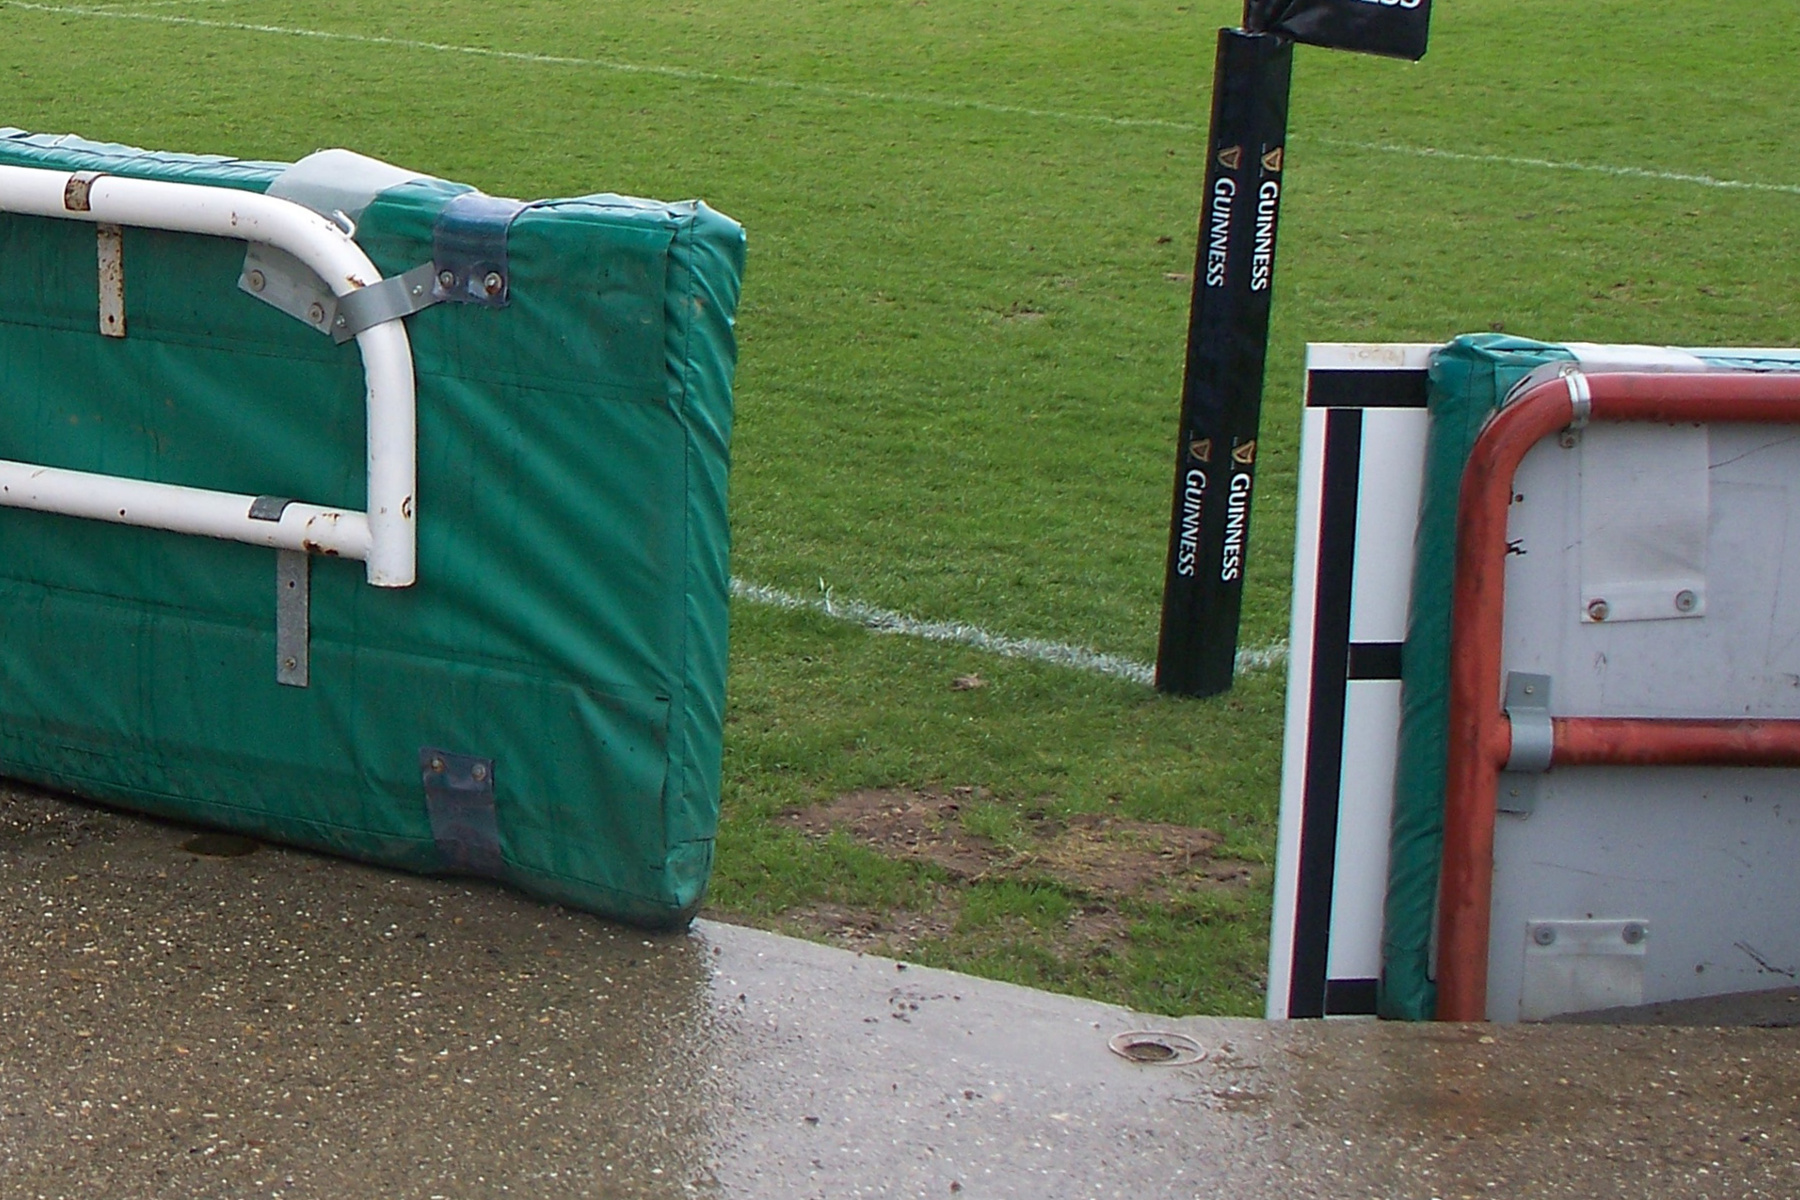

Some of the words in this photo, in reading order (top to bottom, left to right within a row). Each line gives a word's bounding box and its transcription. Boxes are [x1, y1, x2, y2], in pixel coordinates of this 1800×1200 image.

[1206, 177, 1236, 288] GUINNESS
[1251, 181, 1279, 292] GUINNESS
[1177, 469, 1207, 578] GUINNESS
[1221, 473, 1251, 582] GUINNESS
